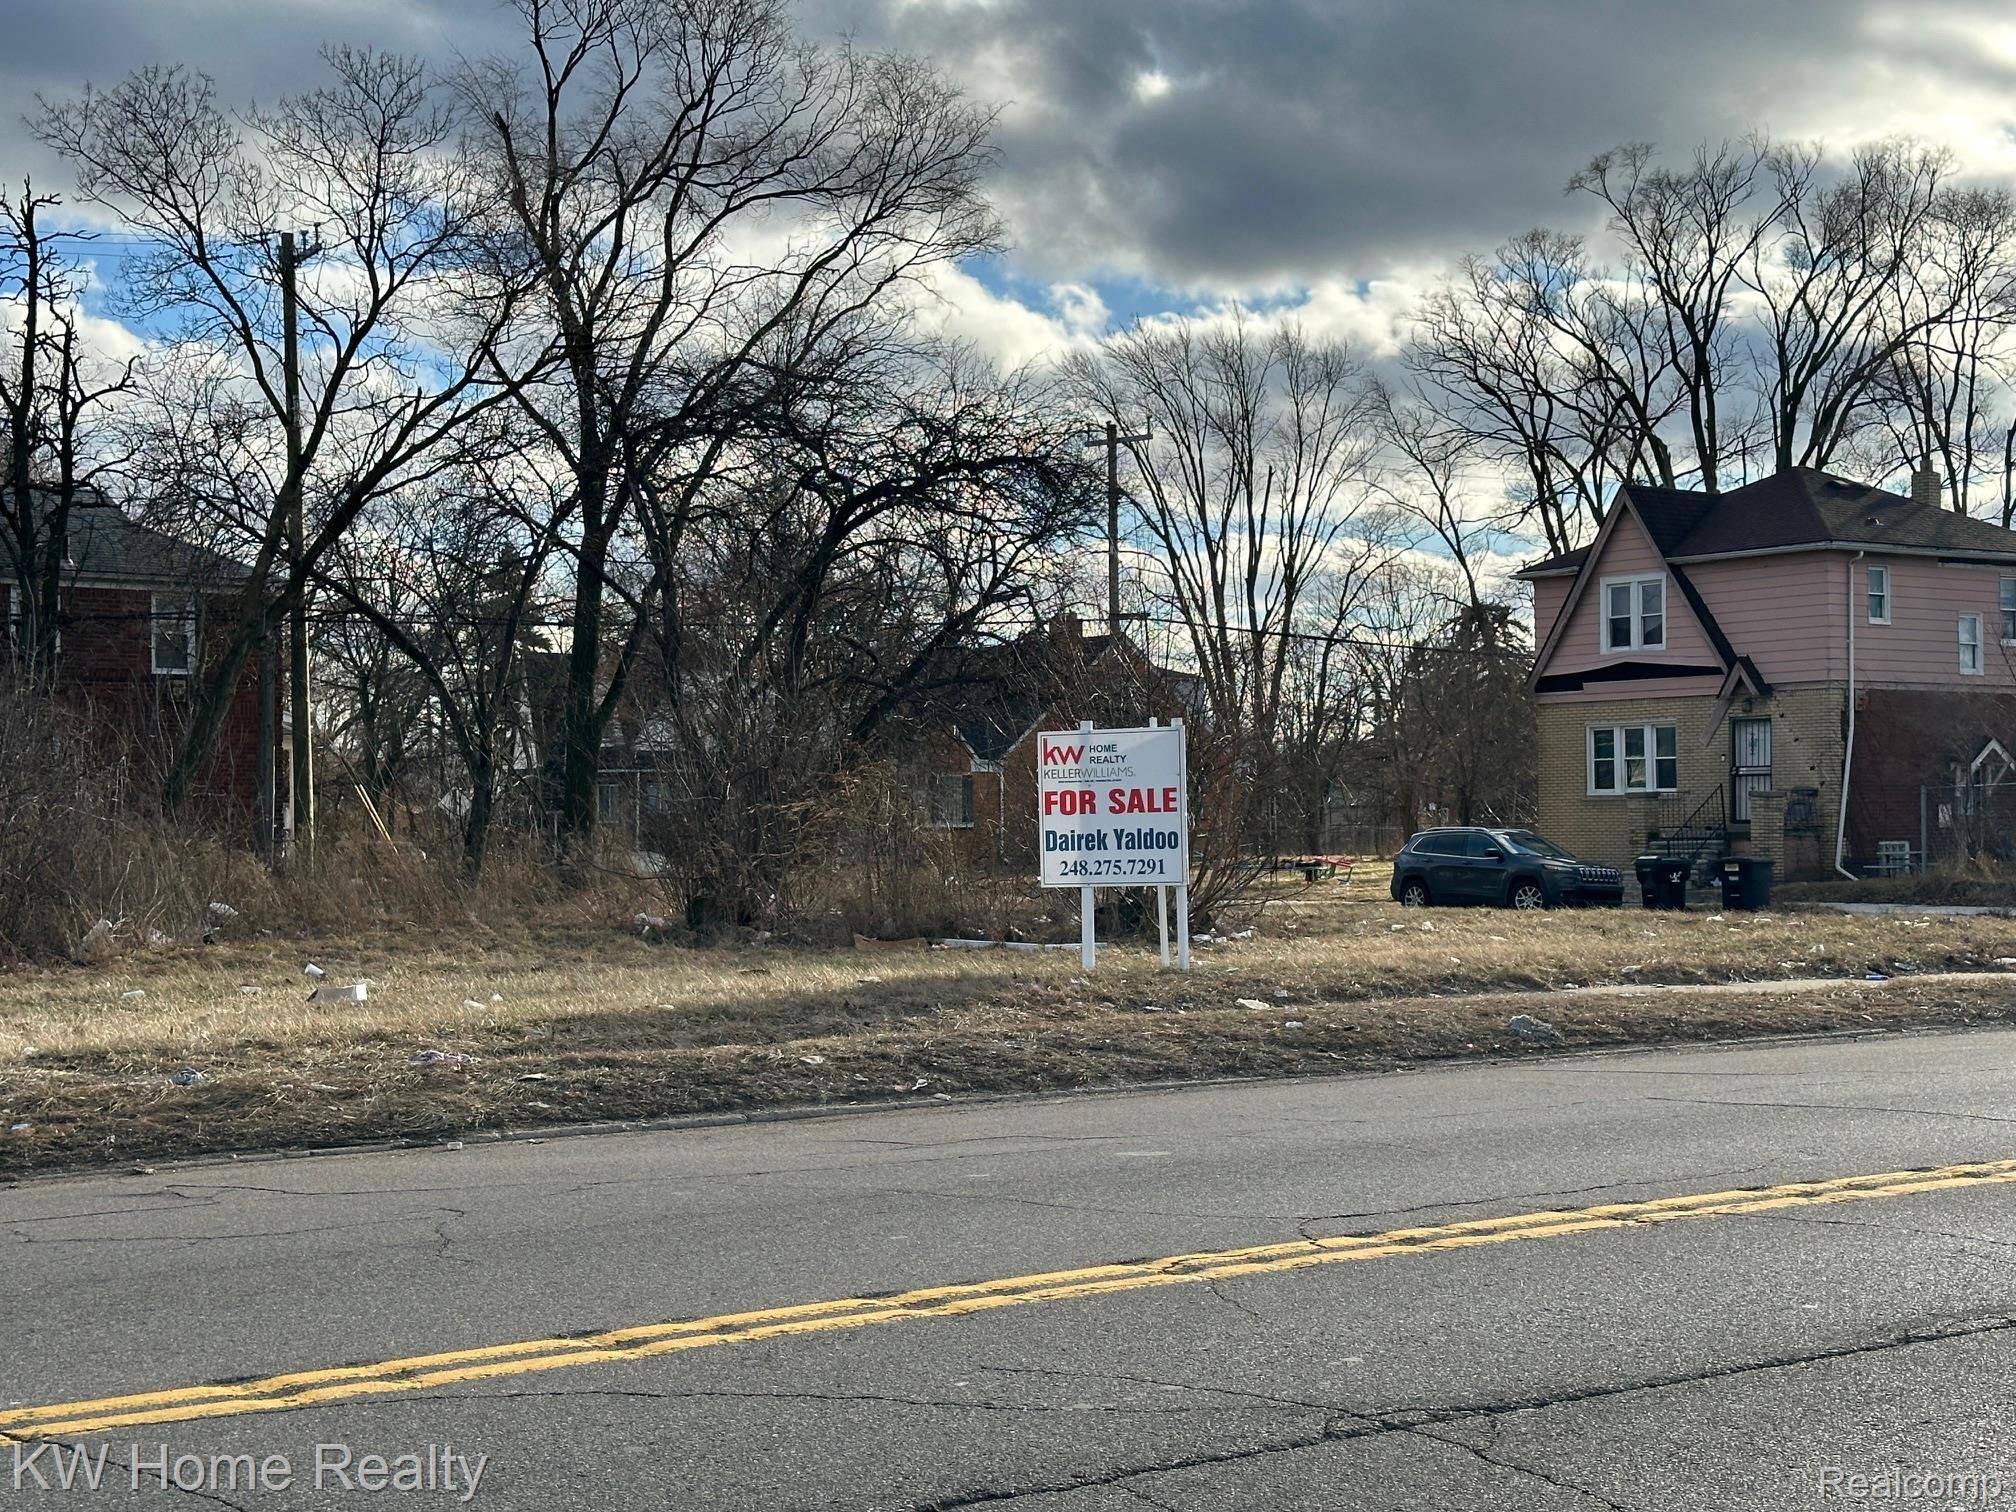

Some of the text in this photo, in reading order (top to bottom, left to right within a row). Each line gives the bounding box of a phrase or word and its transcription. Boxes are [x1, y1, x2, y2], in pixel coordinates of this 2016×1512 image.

[1089, 744, 1117, 753] HOME
[1089, 755, 1127, 764] REALTY
[1044, 787, 1178, 815] FOR SALE
[1045, 828, 1179, 852] Dairek Yaldoo
[1059, 858, 1166, 876] 248.275.7291
